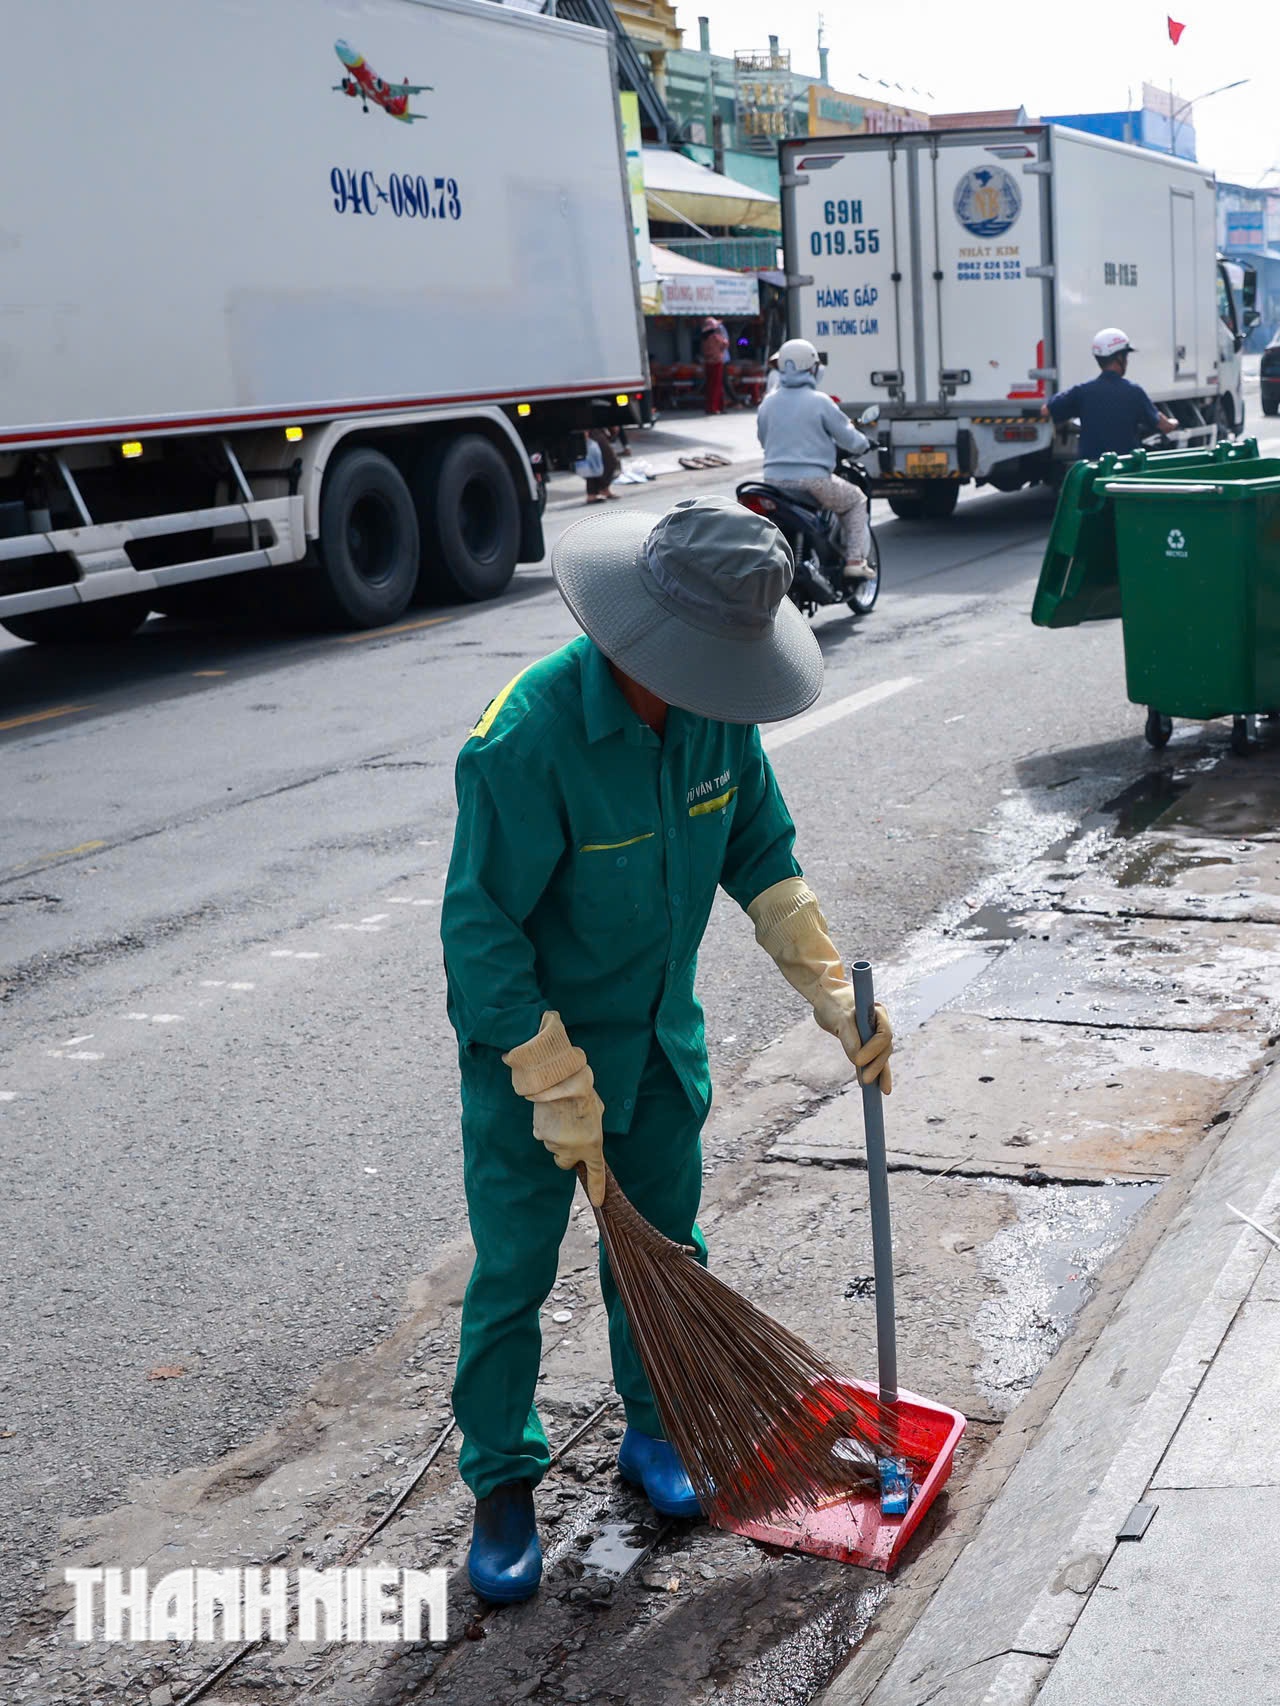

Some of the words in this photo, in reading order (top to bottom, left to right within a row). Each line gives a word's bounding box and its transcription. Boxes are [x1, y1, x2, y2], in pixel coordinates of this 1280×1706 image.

[331, 167, 461, 220] 94C-080.73
[824, 199, 863, 225] 69H
[810, 228, 880, 256] 019.55
[817, 321, 829, 336] XIN
